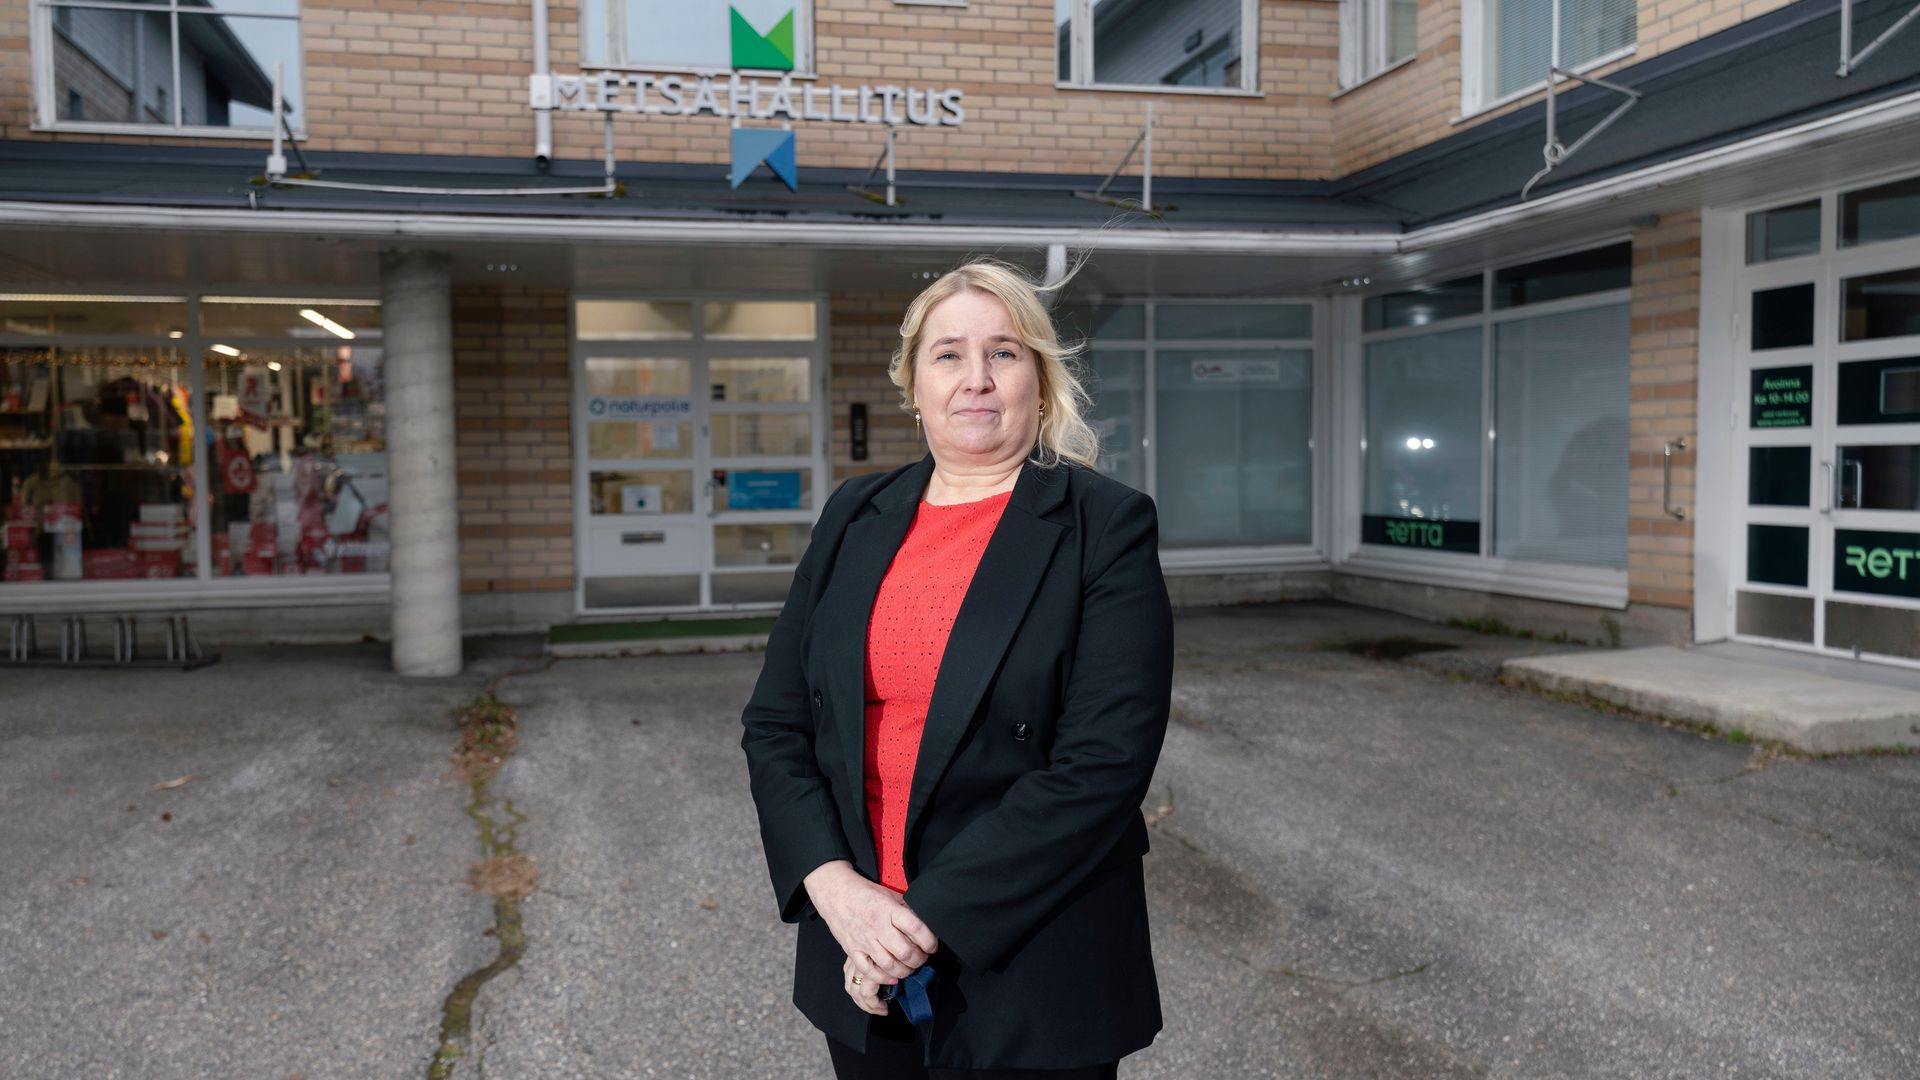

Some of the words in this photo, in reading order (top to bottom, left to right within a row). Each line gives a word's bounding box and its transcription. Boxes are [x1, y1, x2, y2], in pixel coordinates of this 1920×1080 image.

[551, 71, 965, 126] METSÄHALLITUS
[1763, 378, 1800, 390] Avoinna
[608, 400, 690, 416] naturpolis
